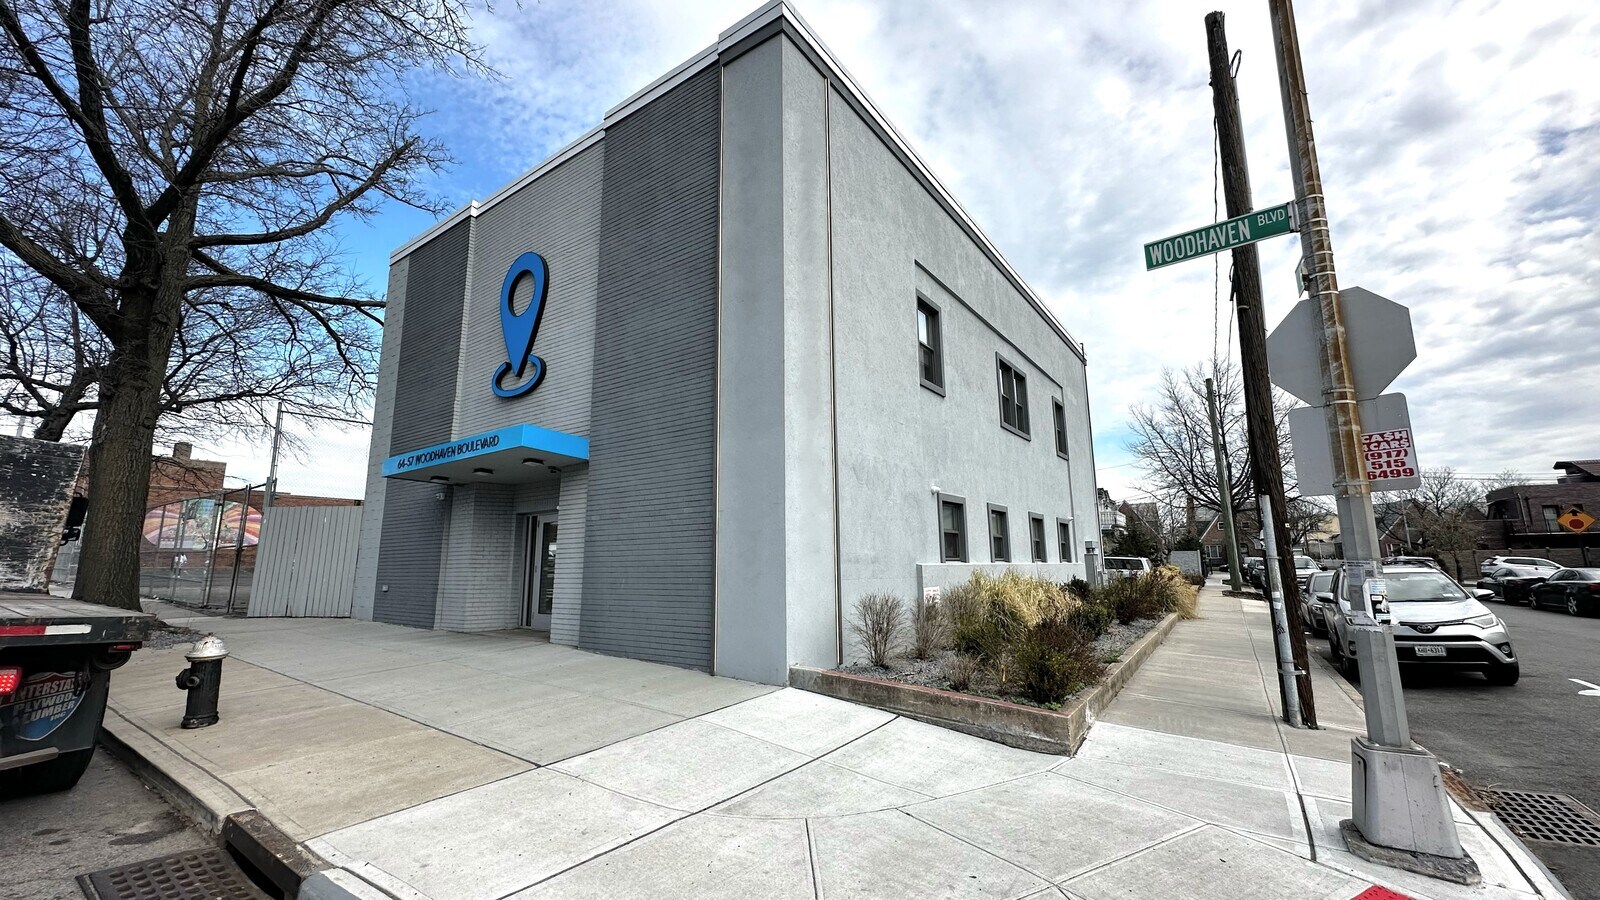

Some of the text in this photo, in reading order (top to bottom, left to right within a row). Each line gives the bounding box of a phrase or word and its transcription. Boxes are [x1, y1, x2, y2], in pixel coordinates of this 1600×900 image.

[1149, 209, 1286, 266] WOODHAVEN BLVD
[1361, 431, 1407, 443] CASH
[397, 435, 500, 469] 64-57 WOODHAVEN BOULEVARD
[1365, 449, 1408, 461] (917)
[1371, 459, 1406, 470] 515
[1367, 468, 1415, 480] 6499
